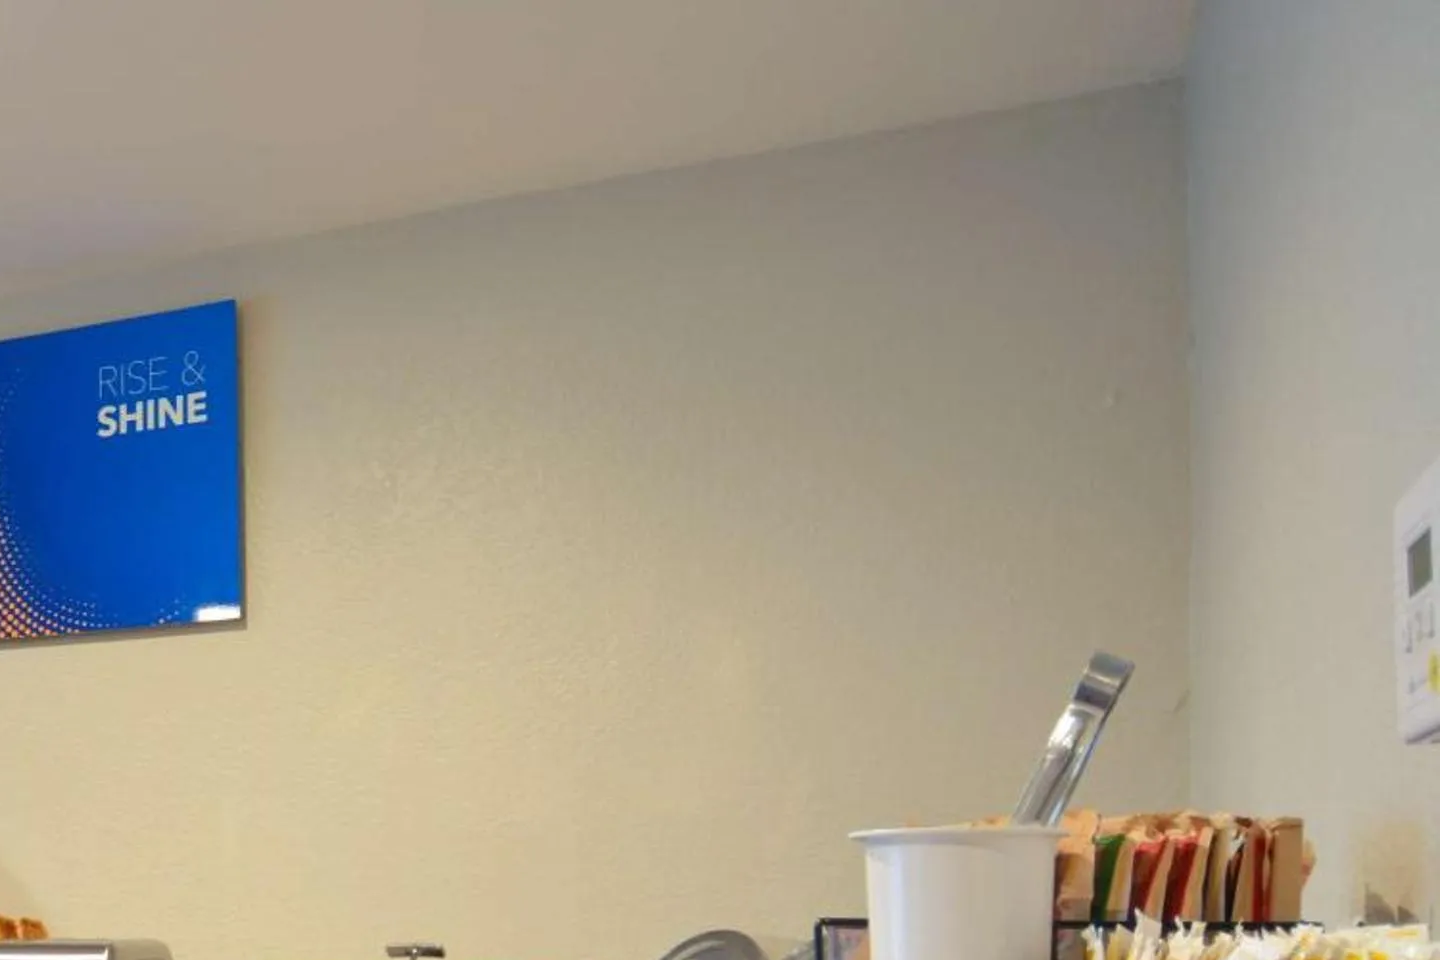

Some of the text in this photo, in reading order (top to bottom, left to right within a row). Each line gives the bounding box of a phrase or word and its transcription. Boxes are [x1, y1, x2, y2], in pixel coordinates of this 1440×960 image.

[99, 350, 206, 400] RISE &
[97, 391, 208, 438] SHINE
